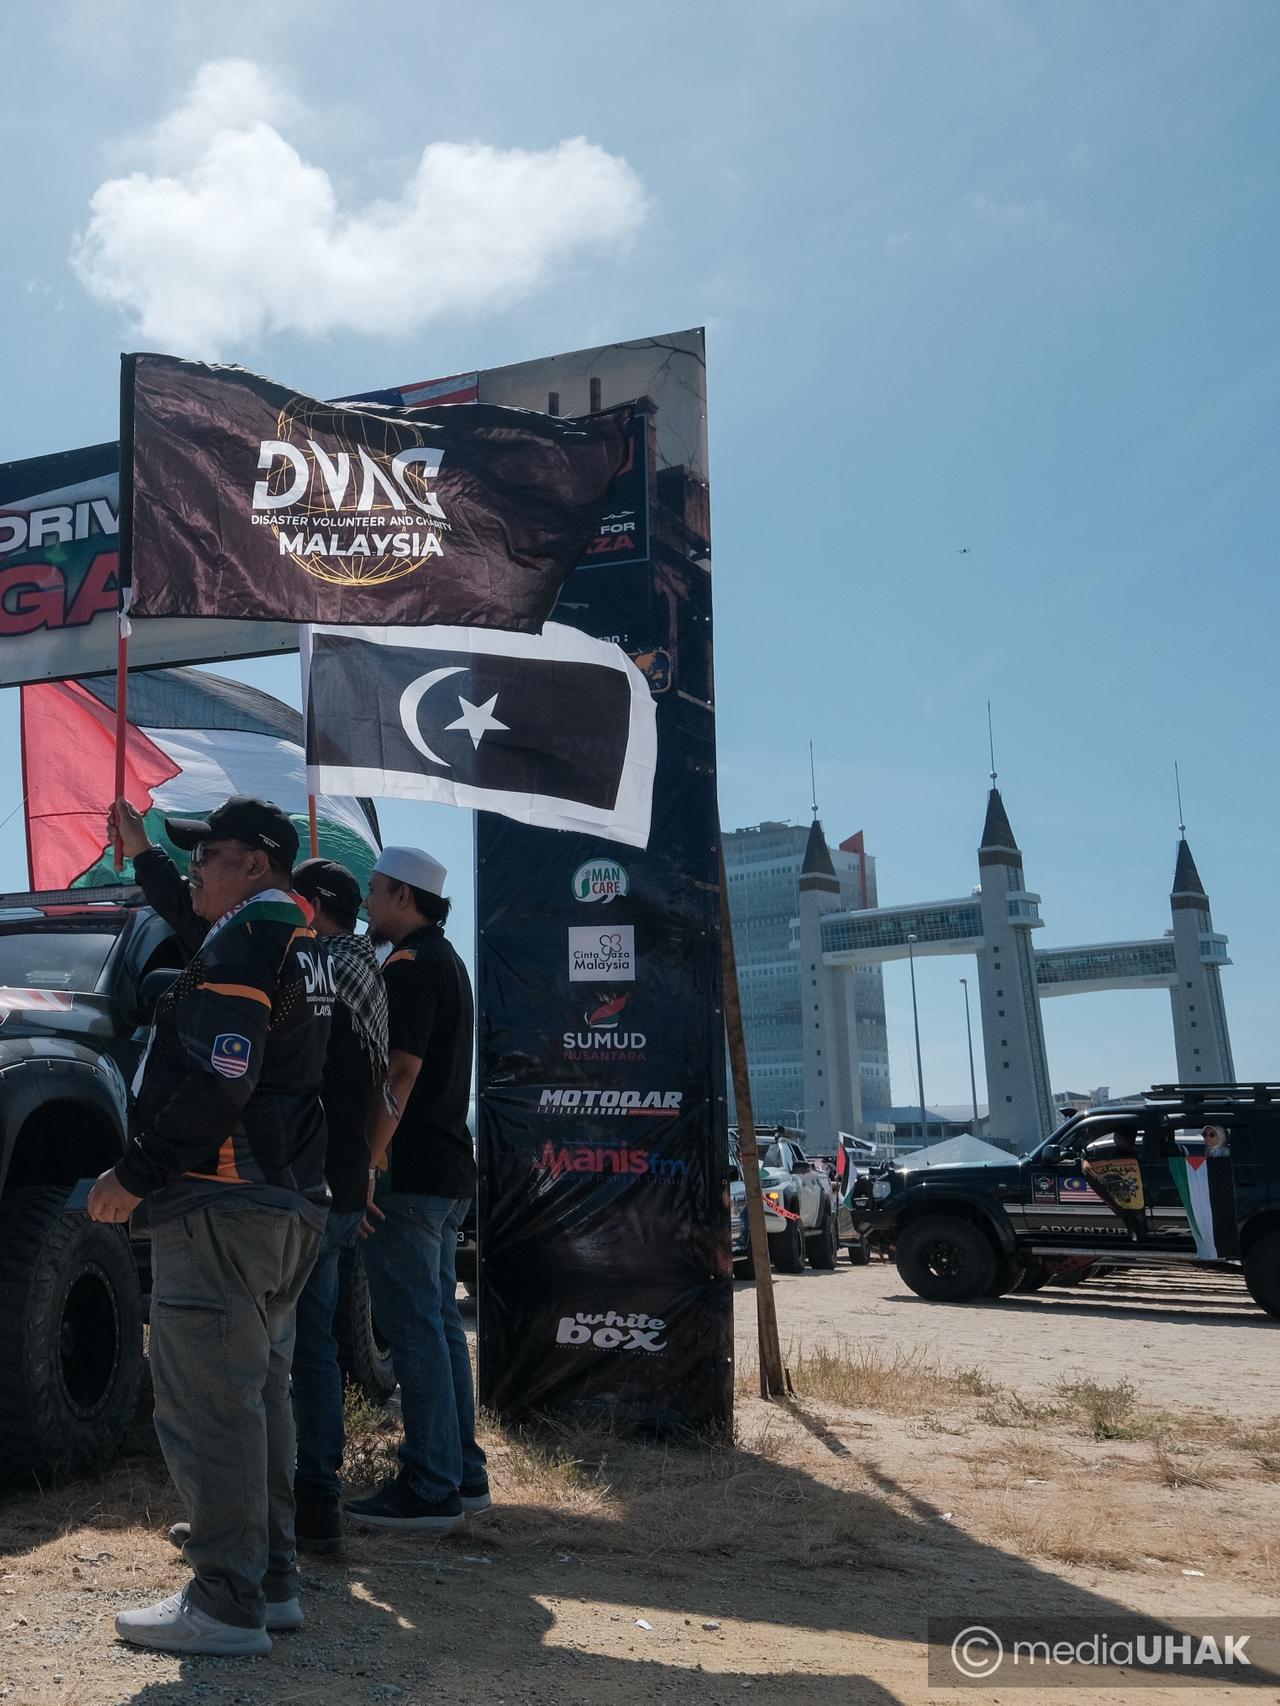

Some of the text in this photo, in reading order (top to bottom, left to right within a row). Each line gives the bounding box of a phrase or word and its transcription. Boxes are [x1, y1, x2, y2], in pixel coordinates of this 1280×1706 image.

[251, 515, 308, 526] DISASTER
[312, 516, 385, 527] VOLUNTEER
[389, 516, 413, 526] AND
[601, 522, 635, 534] FOR
[279, 532, 444, 557] MALAYSIA
[586, 535, 635, 554] ZA
[592, 882, 620, 894] CARE
[573, 951, 599, 959] Cinta
[574, 959, 630, 973] Malaysia
[563, 1032, 647, 1049] SUMUD
[563, 1051, 647, 1061] NUSANTARA
[539, 1089, 683, 1108] MOTOQAR
[534, 1139, 649, 1180] Manis
[575, 1310, 667, 1330] white
[556, 1317, 668, 1352] box
